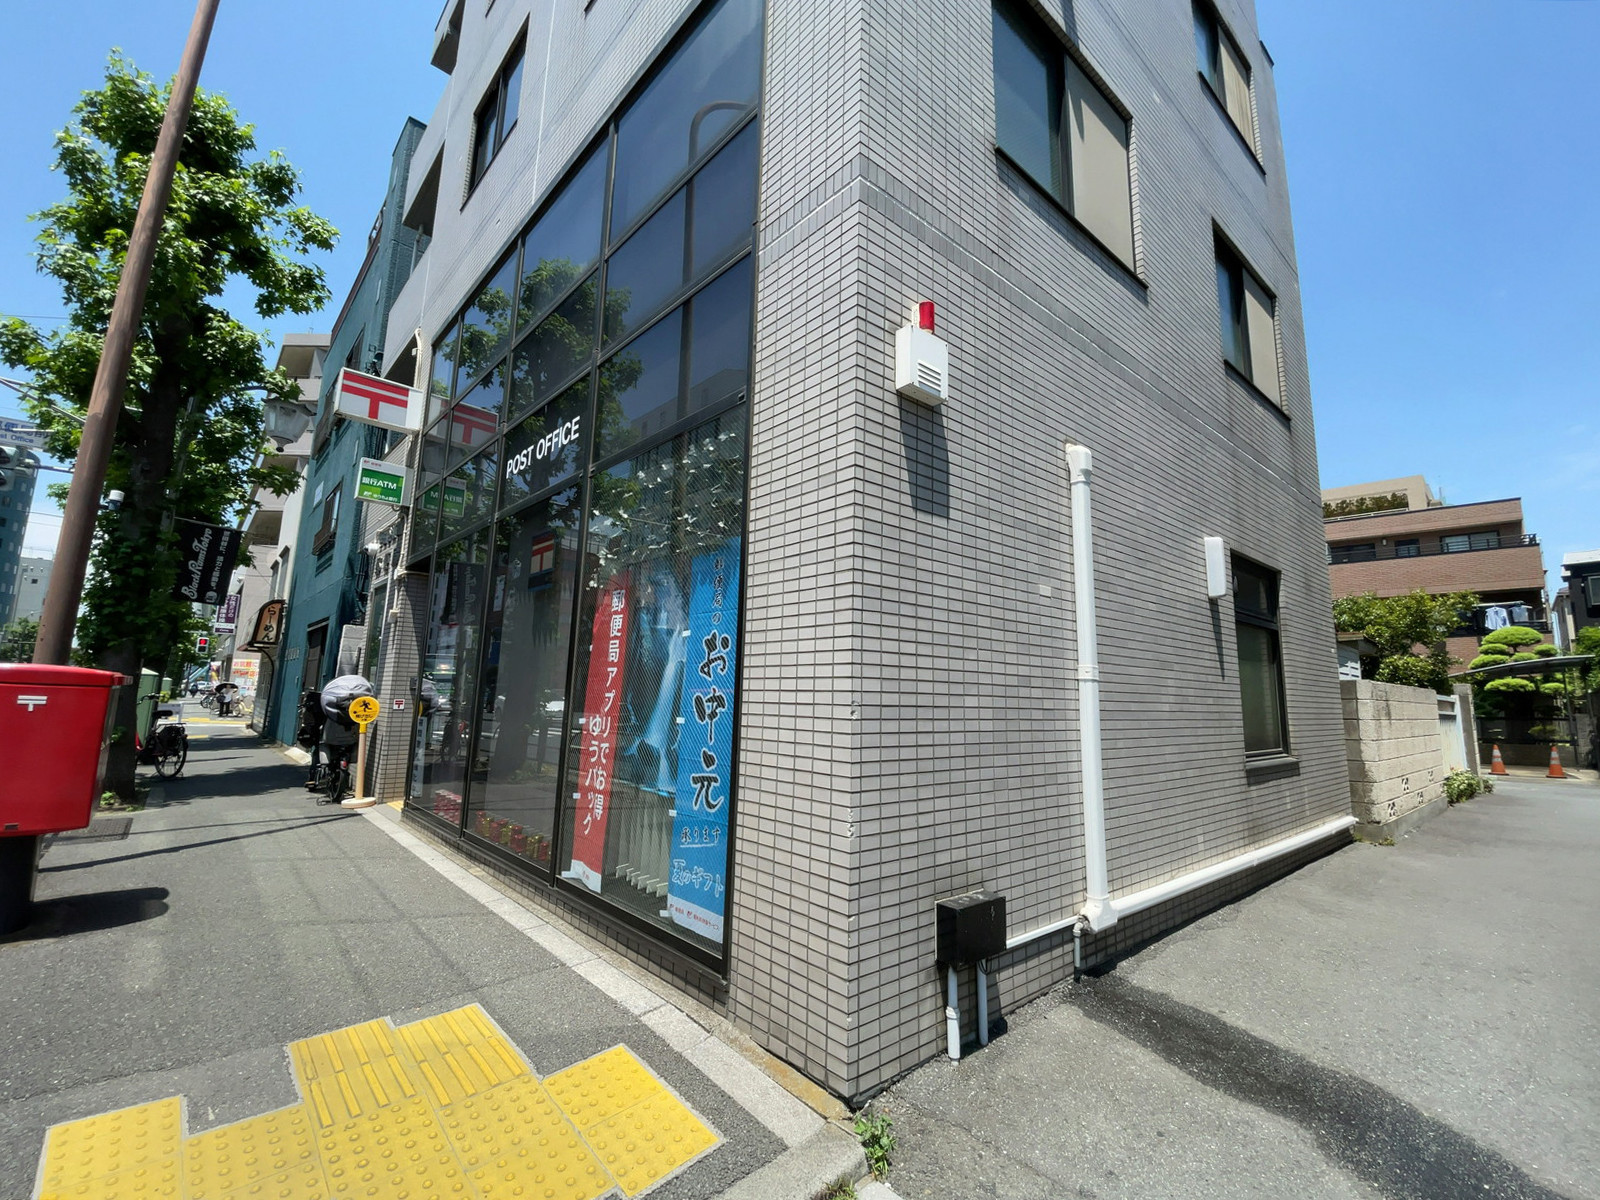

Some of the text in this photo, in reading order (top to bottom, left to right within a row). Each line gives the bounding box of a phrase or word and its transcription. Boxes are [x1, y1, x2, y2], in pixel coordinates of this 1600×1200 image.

[506, 416, 580, 479] POST OFFICE
[361, 476, 397, 490] 銀行ATM
[261, 606, 277, 641] らーめん
[691, 630, 732, 813] お中元
[681, 826, 721, 844] 承ります
[672, 859, 724, 898] 夏のギフト
